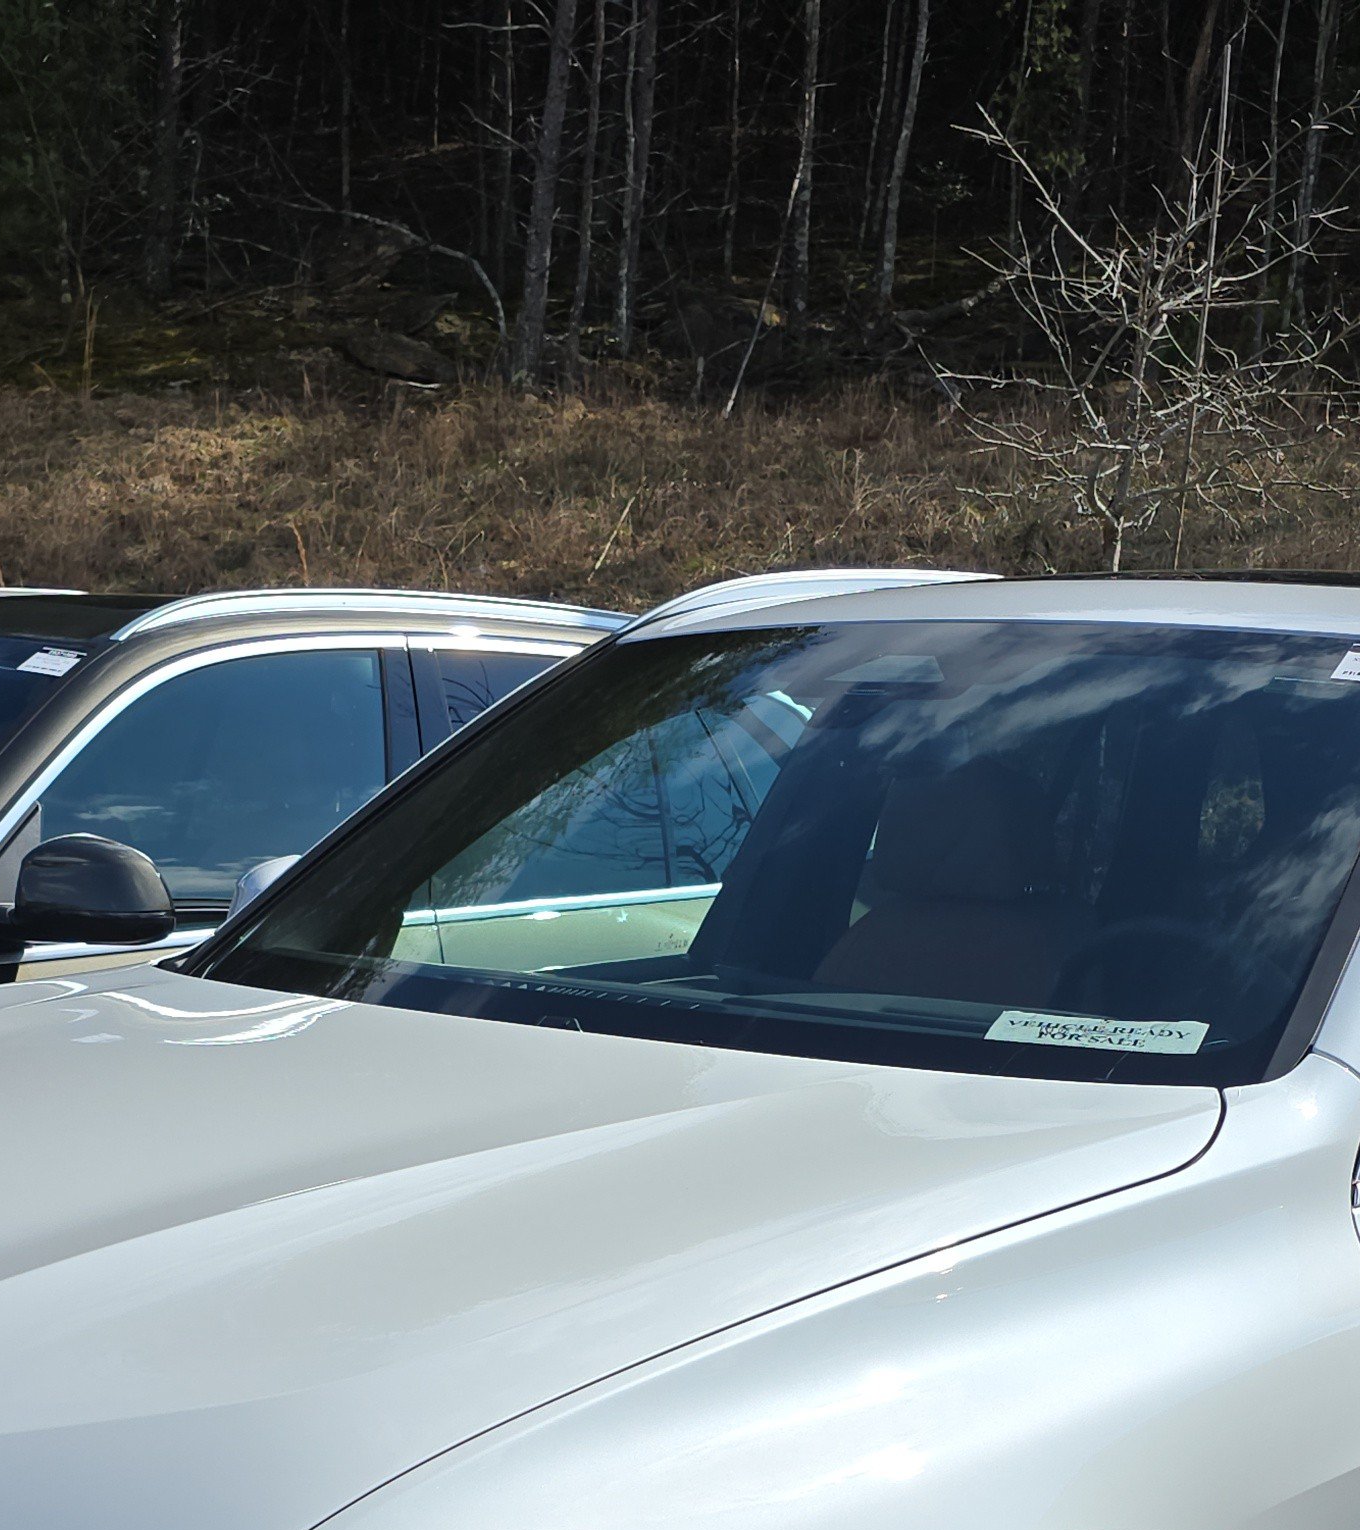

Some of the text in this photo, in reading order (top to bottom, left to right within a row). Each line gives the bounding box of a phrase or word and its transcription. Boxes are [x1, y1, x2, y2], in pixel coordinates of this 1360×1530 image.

[1007, 1019, 1191, 1040] VEHICLE READY
[1037, 1031, 1147, 1048] FOR SALE
